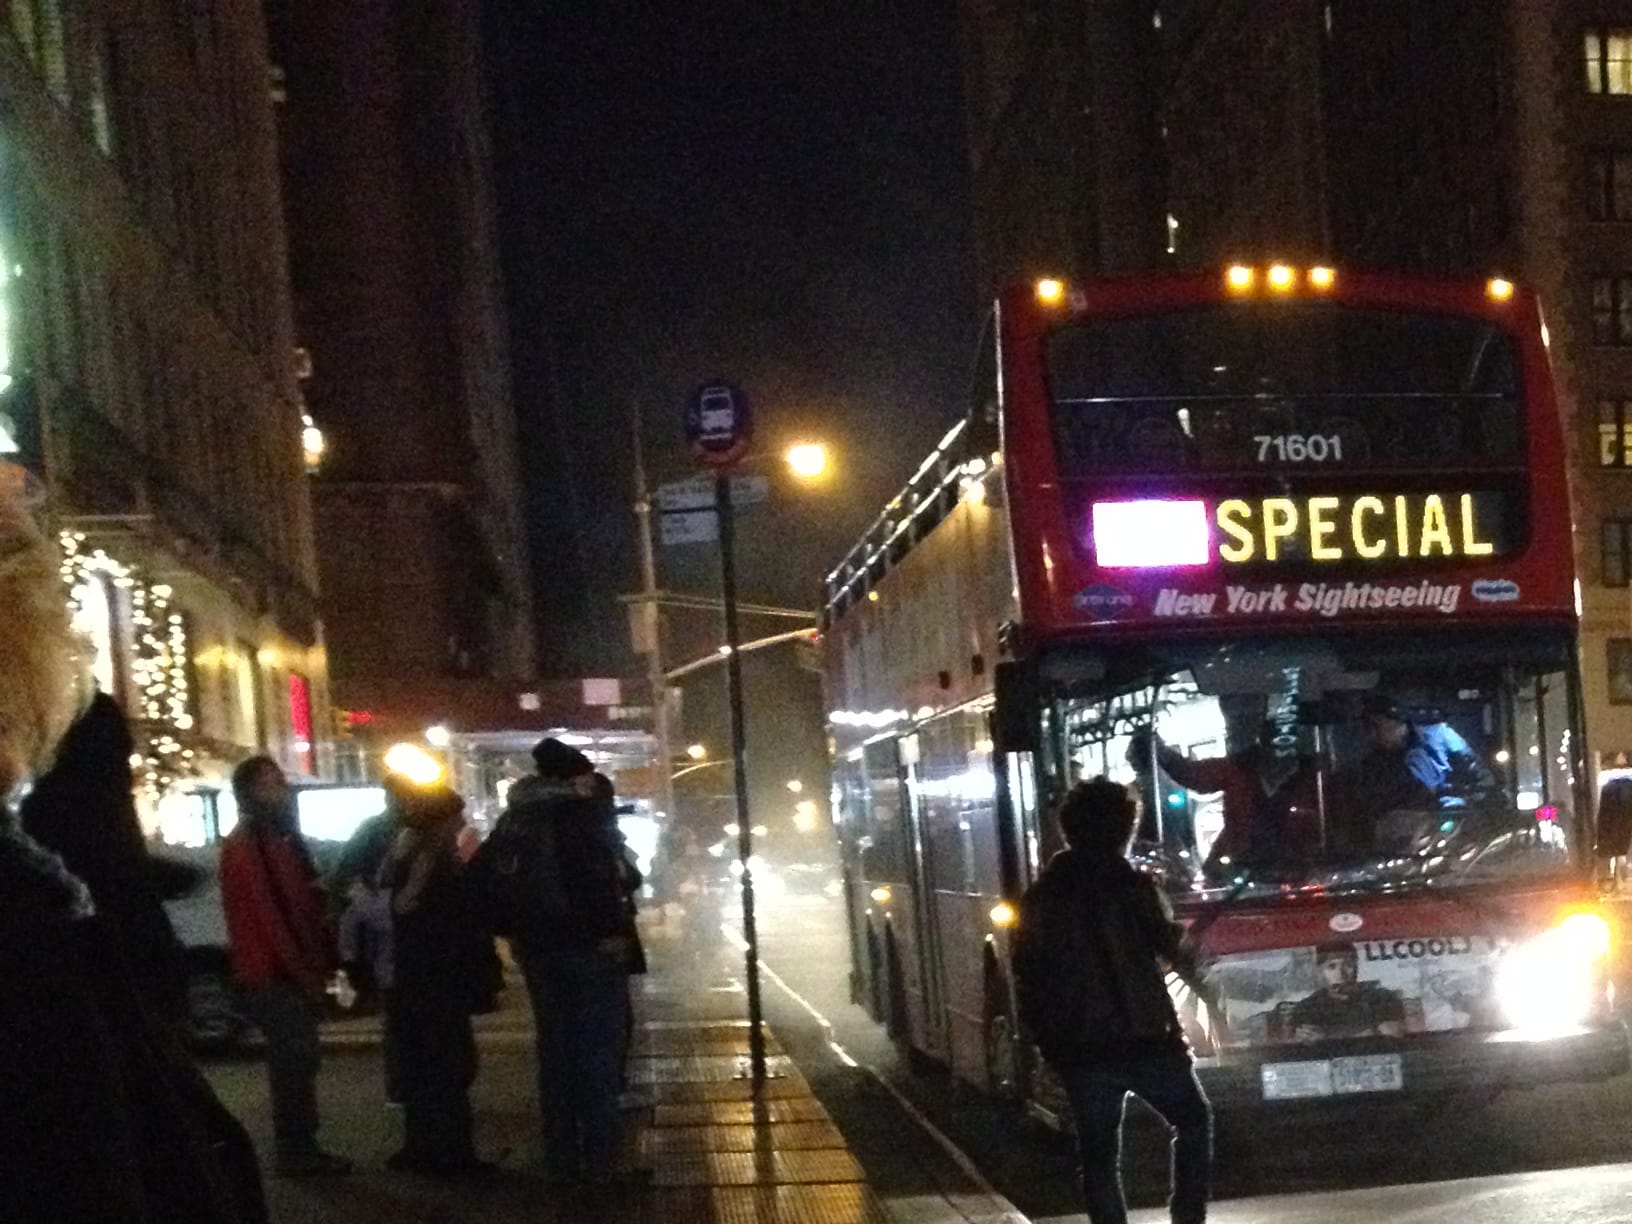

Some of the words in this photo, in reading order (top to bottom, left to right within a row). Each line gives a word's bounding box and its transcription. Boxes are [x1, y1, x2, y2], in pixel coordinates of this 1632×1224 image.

[1253, 434, 1342, 461] 71601
[1216, 494, 1493, 562] SPECIAL
[1154, 588, 1217, 617] New
[1226, 583, 1289, 614] York
[1294, 579, 1462, 617] Sightseeing
